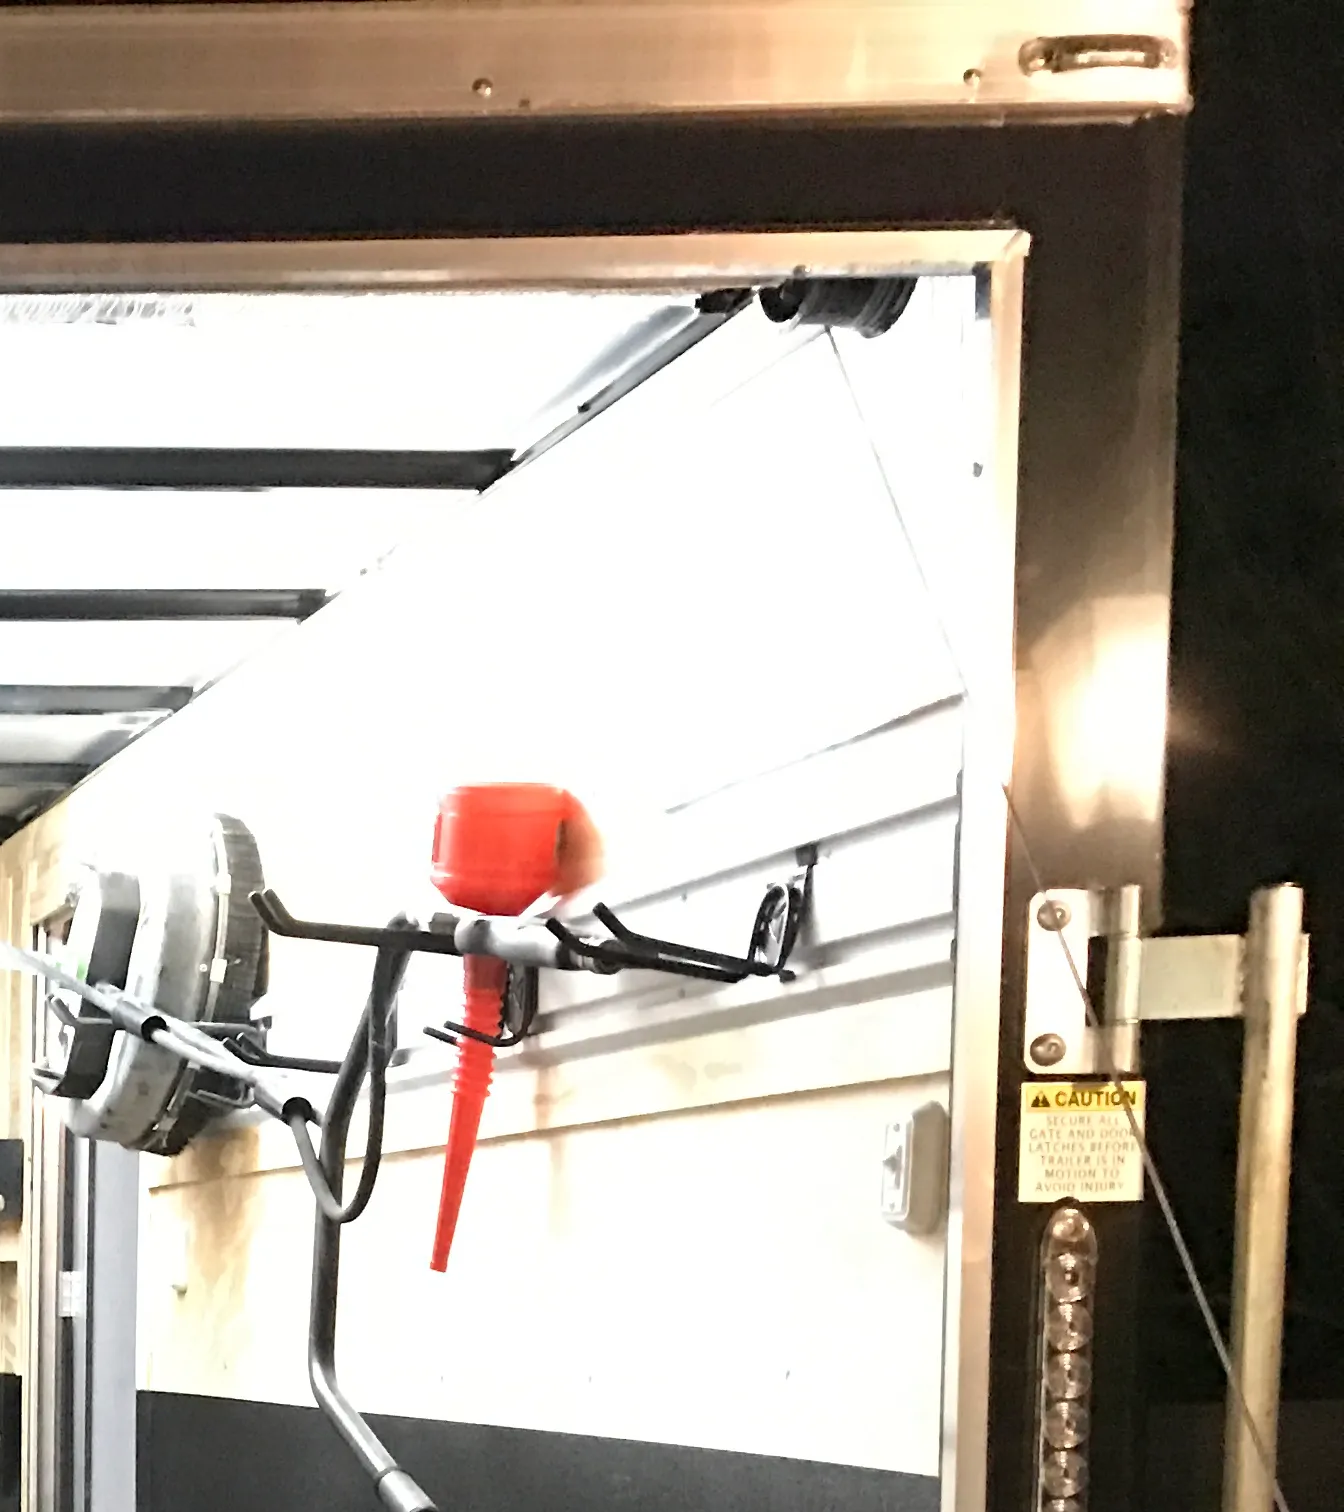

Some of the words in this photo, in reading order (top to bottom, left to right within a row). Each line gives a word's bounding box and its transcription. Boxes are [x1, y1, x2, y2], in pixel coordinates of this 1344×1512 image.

[1055, 1090, 1137, 1107] CAUTION
[1046, 1116, 1091, 1127] SECURE
[1099, 1115, 1119, 1126] ALL
[1029, 1128, 1061, 1140] GATE
[1068, 1128, 1095, 1140] AND
[1028, 1141, 1085, 1153] LATCHES
[1090, 1141, 1136, 1152] BEFORE
[1041, 1155, 1091, 1166] TRAILER
[1096, 1155, 1107, 1166] IS
[1113, 1155, 1126, 1166] IN
[1045, 1168, 1096, 1180] MOTION
[1103, 1168, 1120, 1179] TO
[1035, 1182, 1075, 1193] AVOID
[1080, 1181, 1124, 1192] INJURY
